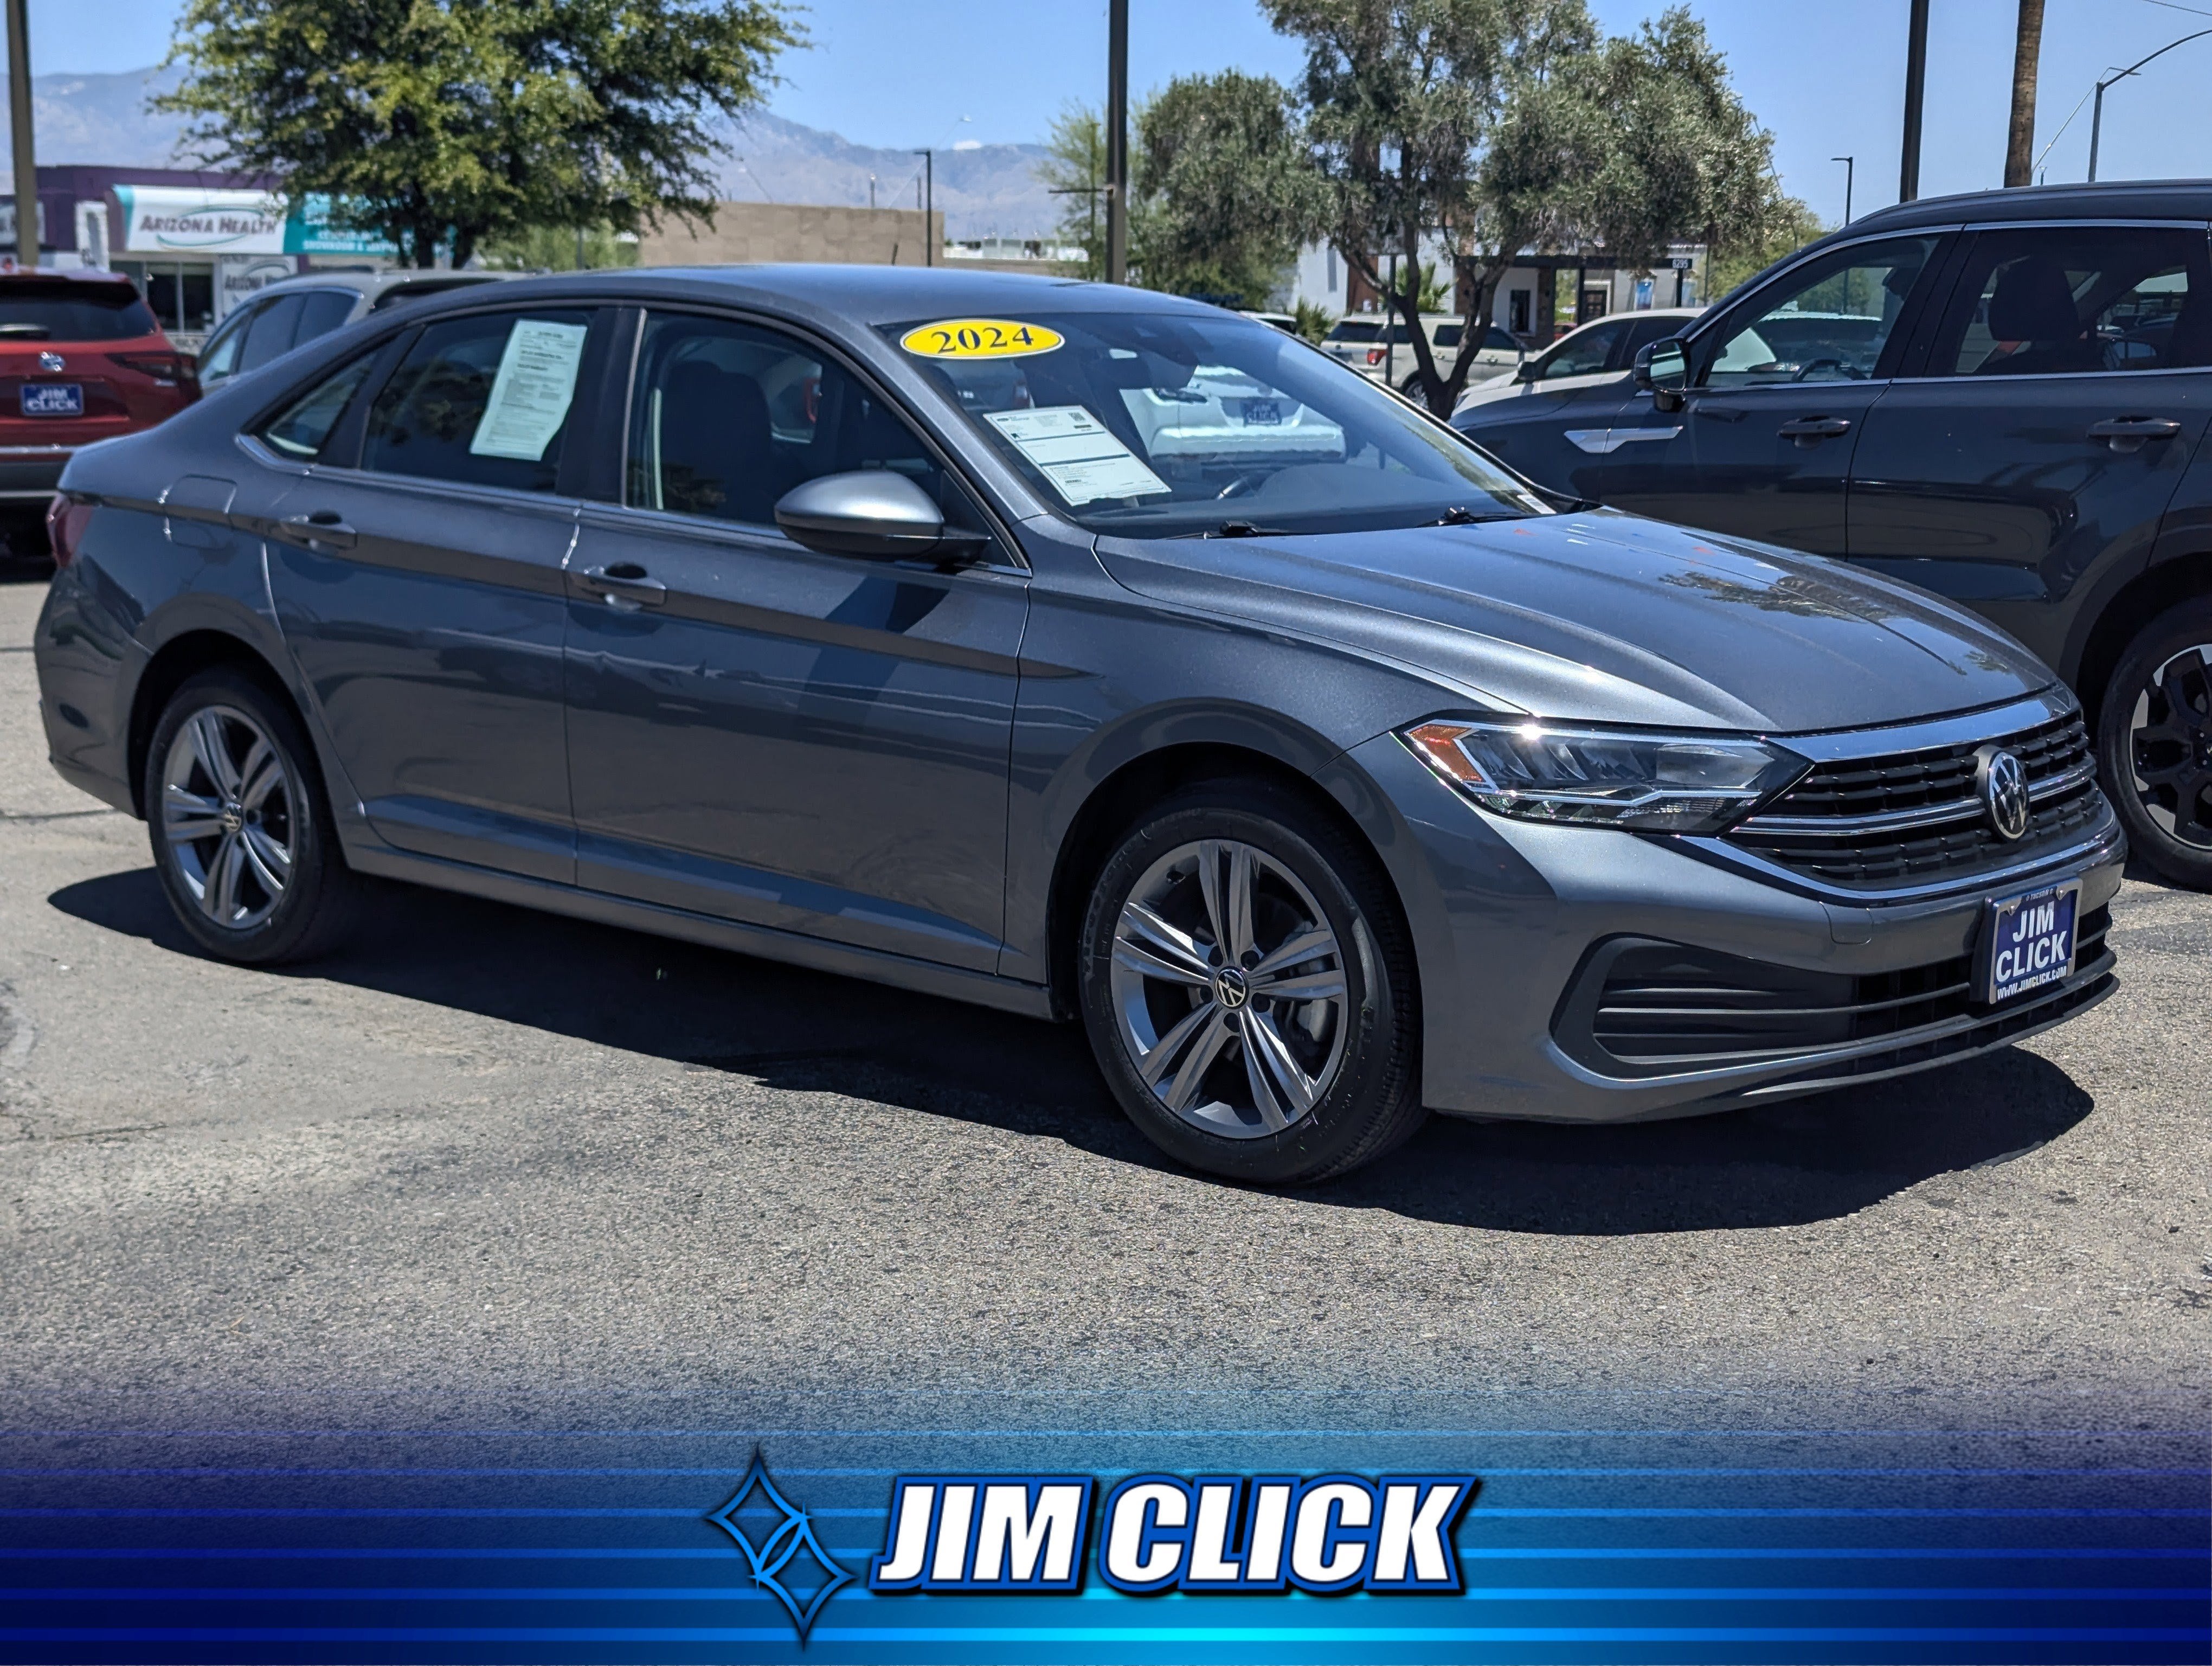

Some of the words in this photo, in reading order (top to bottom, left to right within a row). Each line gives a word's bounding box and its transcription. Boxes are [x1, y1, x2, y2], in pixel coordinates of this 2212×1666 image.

[139, 214, 214, 232] ARIZONA
[931, 326, 1034, 353] 2024
[28, 398, 78, 411] CLICK
[2012, 901, 2054, 942] JIM
[1996, 931, 2067, 982] CLICK
[1997, 966, 2067, 1000] WWW.JIMCLICK.COM
